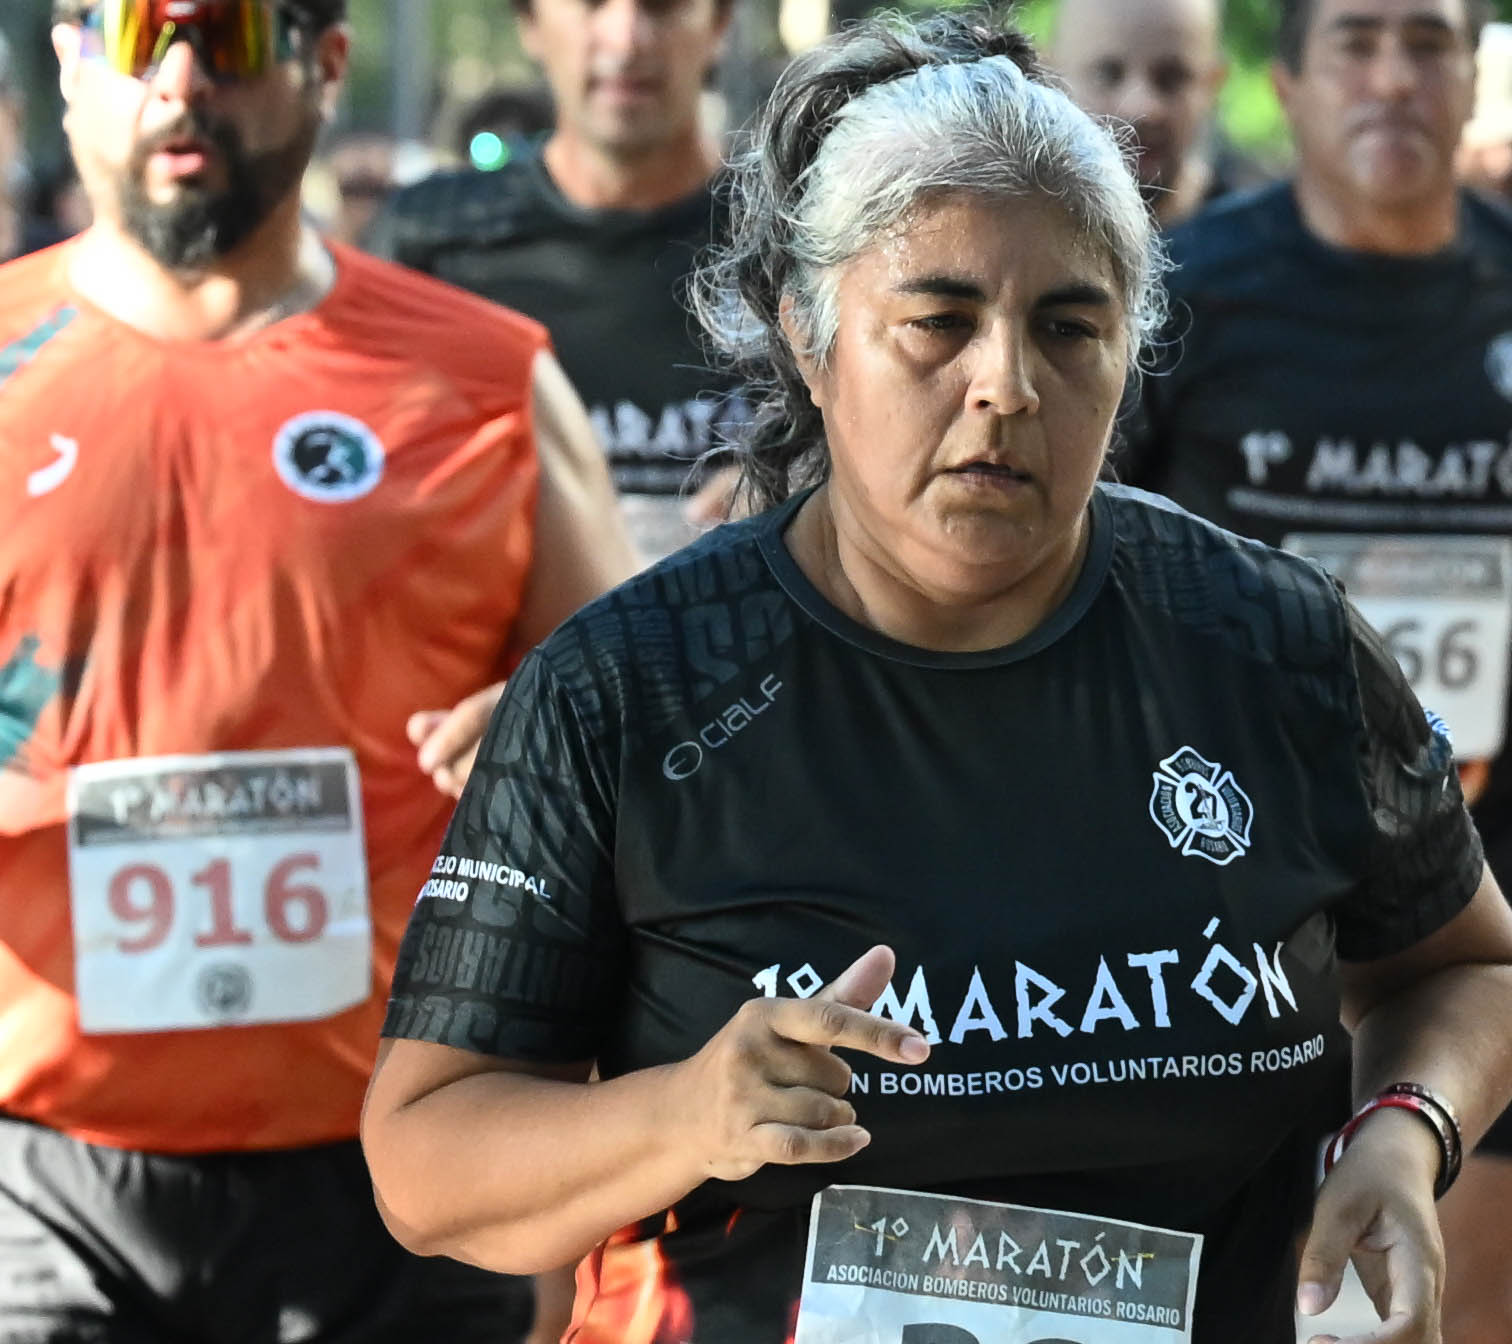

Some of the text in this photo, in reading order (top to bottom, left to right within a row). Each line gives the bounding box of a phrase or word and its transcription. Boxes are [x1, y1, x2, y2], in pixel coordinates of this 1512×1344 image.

[1384, 618, 1480, 692] 66
[106, 851, 329, 955] 916
[456, 857, 551, 899] MUNICIPAL
[867, 916, 1299, 1046] MARATÓN
[880, 1066, 1044, 1097] BOMBEROS
[1053, 1052, 1245, 1088] VOLUNTARIOS
[1250, 1034, 1325, 1073] ROSARIO
[921, 1222, 1145, 1291] MARATÓN
[826, 1263, 1181, 1326] ASOCIACIÓN BOMBEROS VOLUNTARIOS ROSARIO
